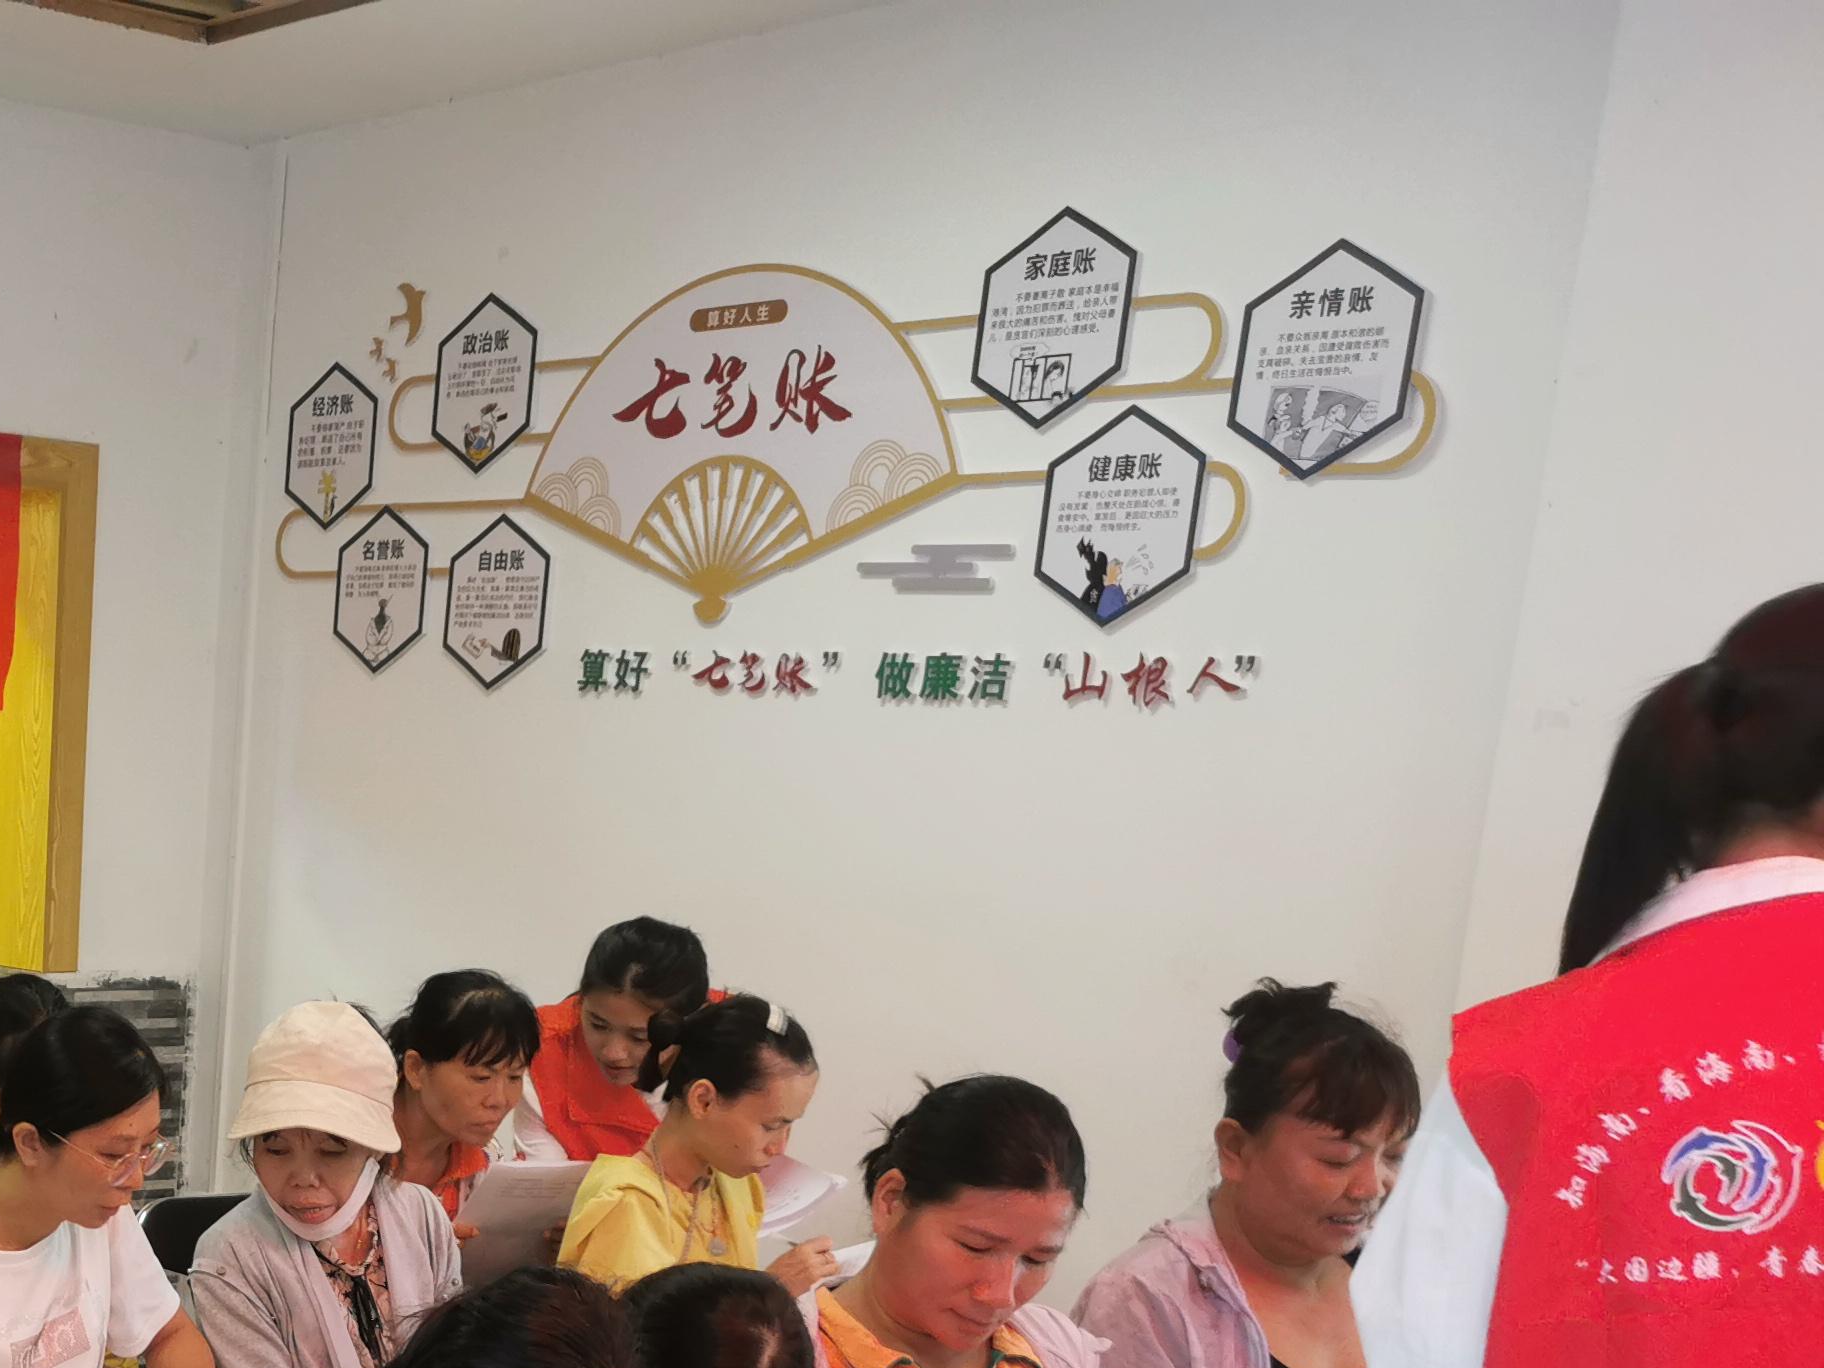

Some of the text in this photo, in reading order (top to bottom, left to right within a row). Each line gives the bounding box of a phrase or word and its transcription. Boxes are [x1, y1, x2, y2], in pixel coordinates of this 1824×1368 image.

[1024, 247, 1097, 280] 家庭账
[1289, 286, 1374, 319] 亲情账
[706, 306, 769, 328] 算好人生
[462, 329, 510, 355] 政治账
[312, 394, 354, 416] 经济账
[612, 345, 852, 439] 七笔账
[1088, 453, 1163, 482] 健康账
[362, 539, 405, 560] 名誉账
[478, 549, 525, 571] 自由账
[1554, 1030, 1824, 1209] 知海南、看海南、
